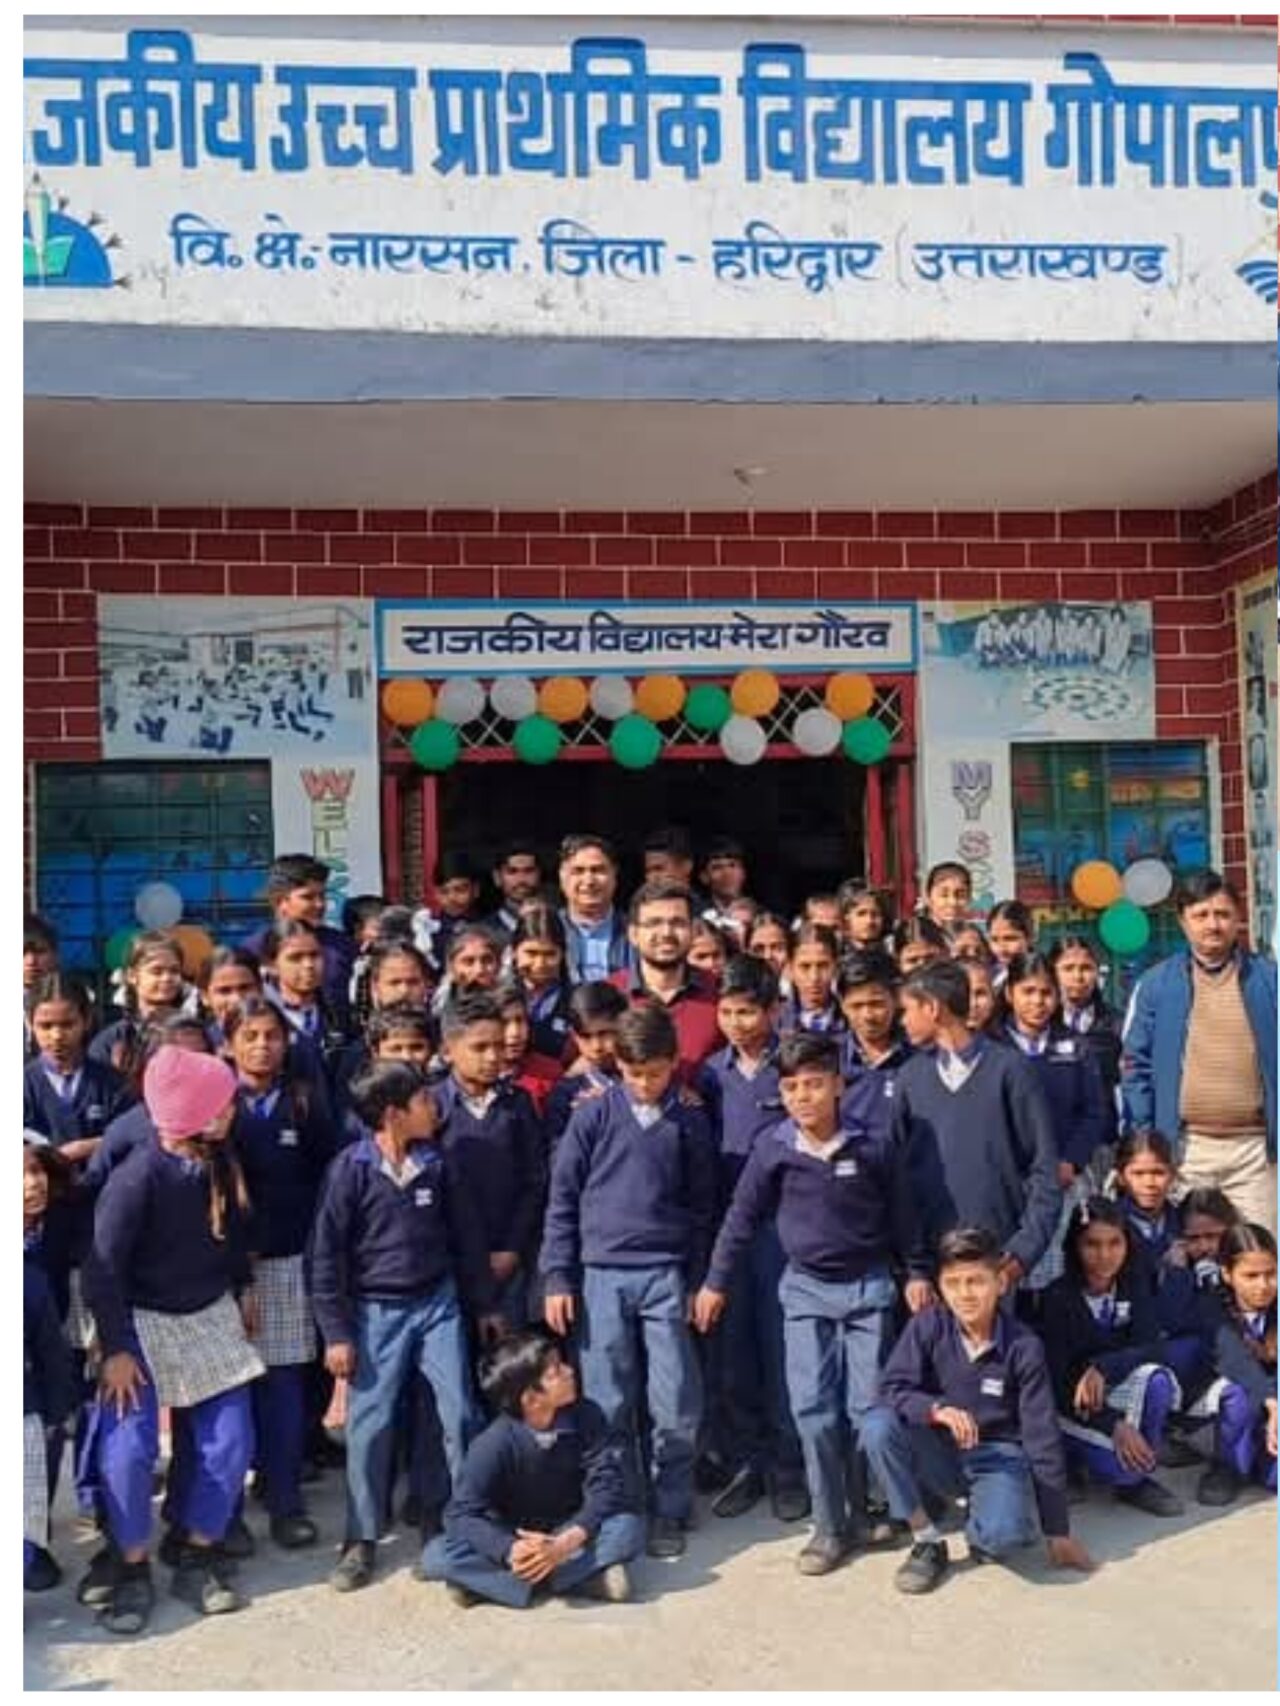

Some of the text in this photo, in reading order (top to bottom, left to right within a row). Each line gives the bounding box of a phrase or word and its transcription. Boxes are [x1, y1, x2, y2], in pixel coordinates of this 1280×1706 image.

[23, 29, 262, 171] जकीय
[269, 65, 417, 176] उच्च
[428, 37, 721, 180] प्राथमिक
[737, 43, 1032, 186] विद्यालय
[538, 218, 666, 279] जिला
[712, 220, 883, 292] हरिद्वार
[402, 612, 583, 654] राजकीय
[727, 611, 793, 651] मेरा
[795, 609, 892, 650] गौरव
[952, 761, 993, 821] MY
